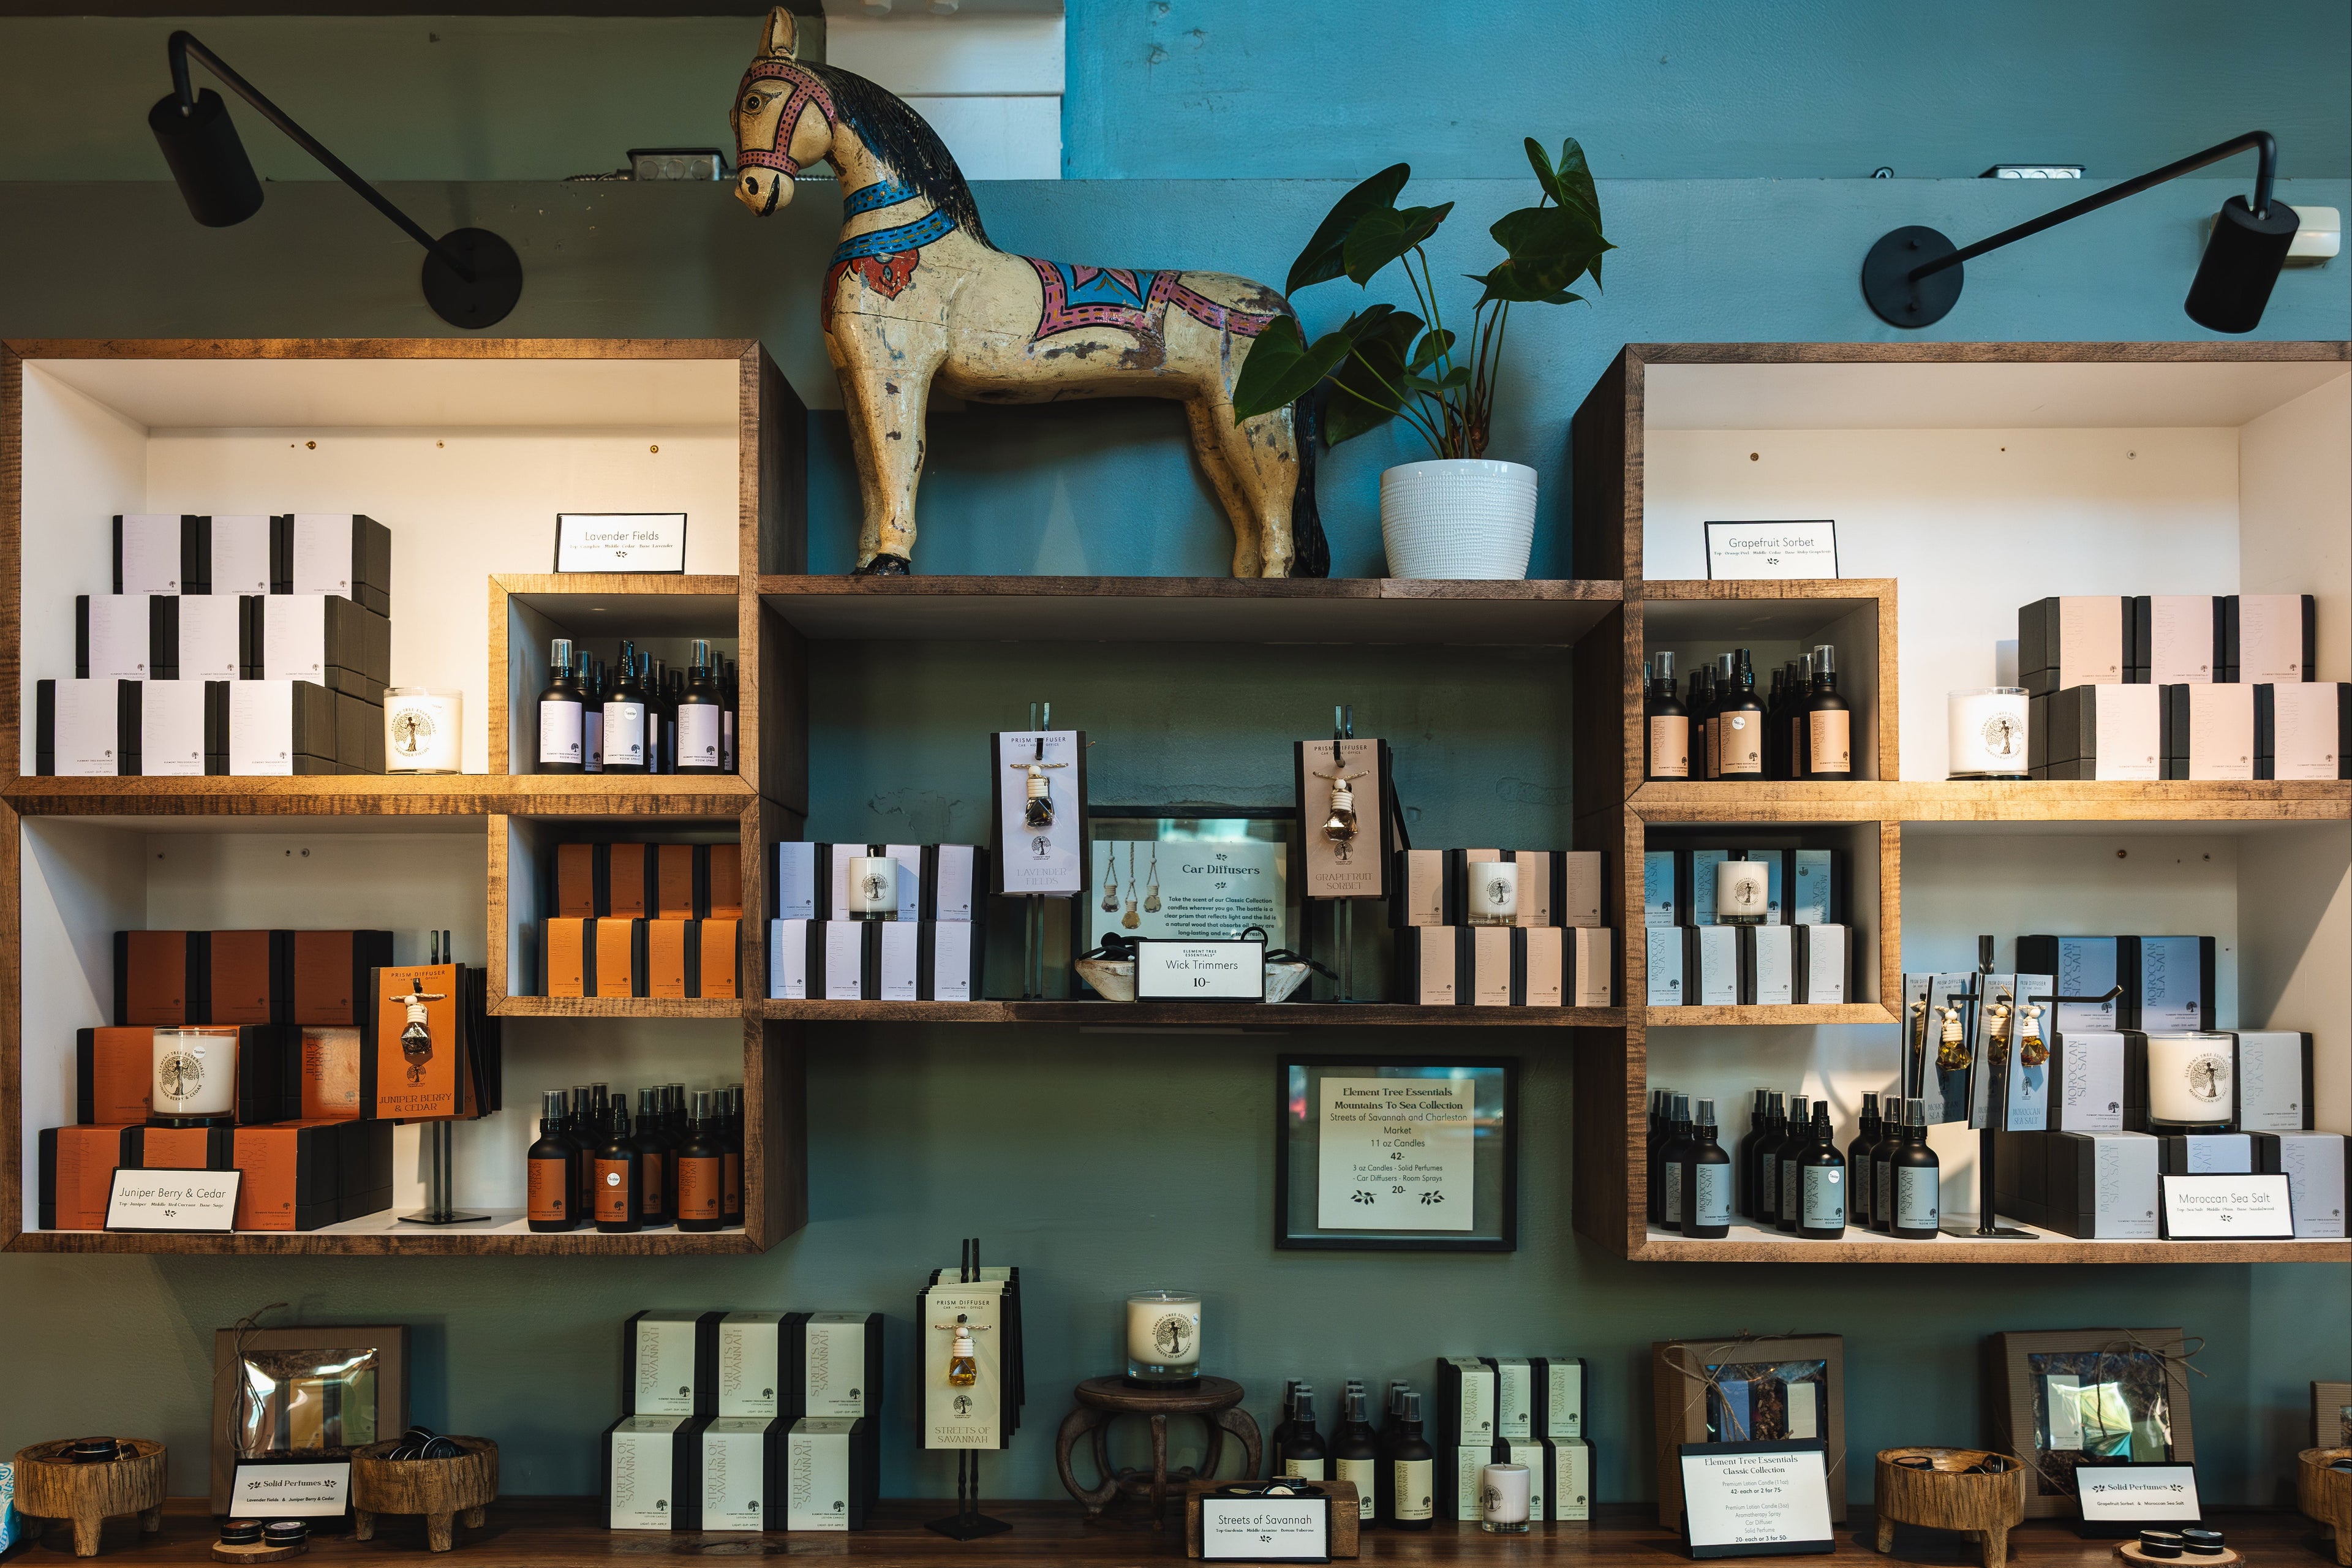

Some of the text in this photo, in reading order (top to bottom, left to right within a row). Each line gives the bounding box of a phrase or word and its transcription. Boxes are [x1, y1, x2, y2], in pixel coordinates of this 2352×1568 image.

[586, 531, 659, 541] Lavender Fields
[1729, 537, 1814, 549] Grapefruit Sorbet
[1182, 864, 1260, 874] Car Diffusers
[1166, 960, 1238, 970] Wick Trimmers
[2157, 943, 2166, 998] SEA SALT
[2147, 943, 2157, 1007] MOROCCAN
[1194, 978, 1210, 987] 10-
[2068, 1041, 2078, 1106] MOROCCAN
[2077, 1041, 2087, 1097] SEA SALT
[1343, 1088, 1379, 1096] Element
[1406, 1088, 1452, 1096] Essentials
[379, 1093, 452, 1104] JUNIPER BERRY
[404, 1102, 437, 1112] CEDAR
[119, 1188, 226, 1200] Juniper Berry & Cedar
[2179, 1193, 2270, 1204] Moroccan Sea Salt
[724, 1329, 733, 1396] STREETS OF
[733, 1329, 742, 1390] SAVANNAH
[1758, 1455, 1798, 1464] Essentials
[1218, 1515, 1311, 1525] Streets of Savannah
